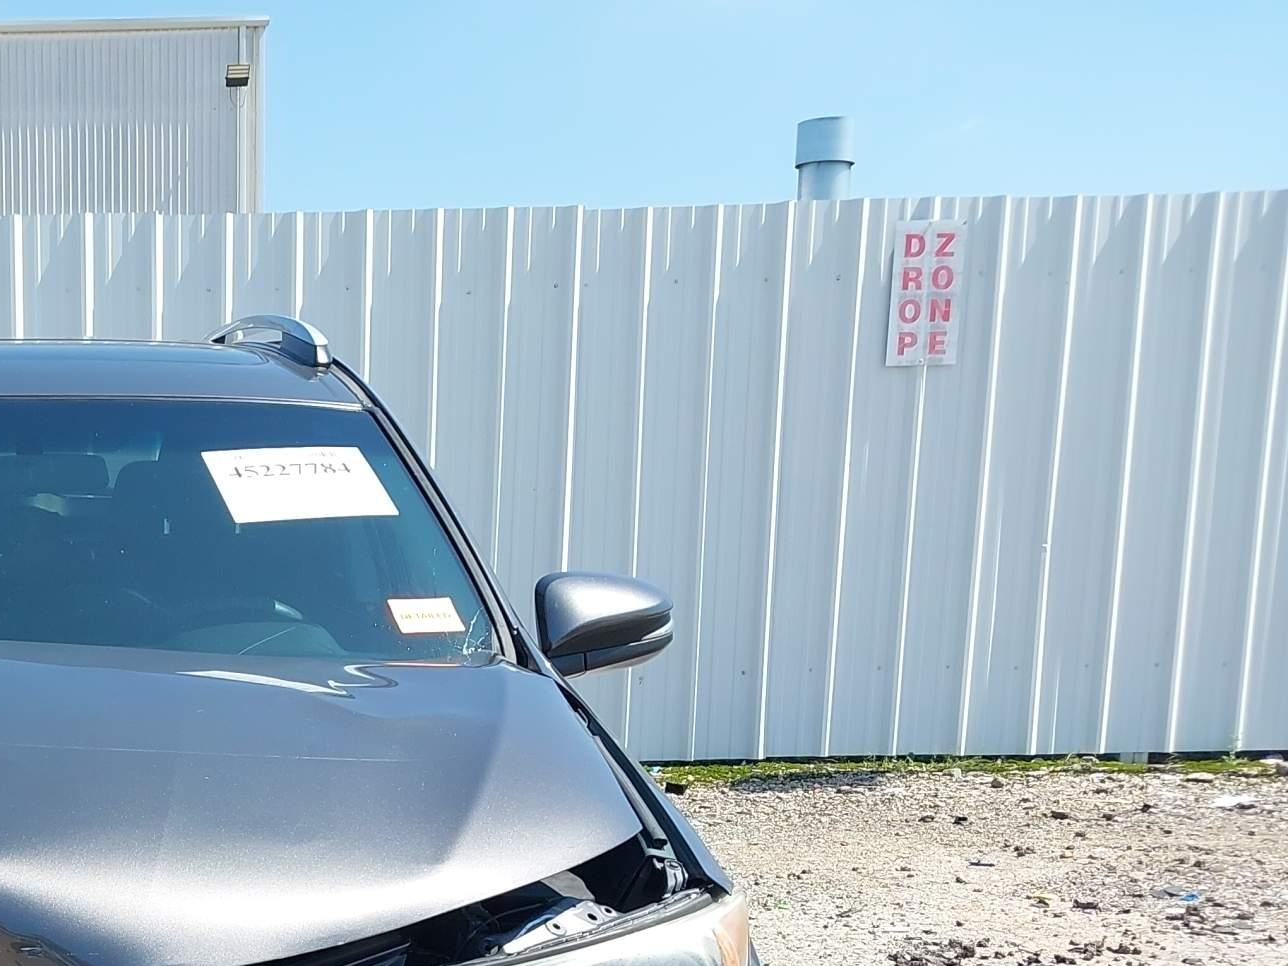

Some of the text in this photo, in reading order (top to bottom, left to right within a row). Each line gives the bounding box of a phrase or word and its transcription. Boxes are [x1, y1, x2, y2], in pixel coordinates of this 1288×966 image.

[897, 233, 926, 356] DROP
[928, 233, 956, 355] ZONE
[229, 462, 352, 479] 45227784
